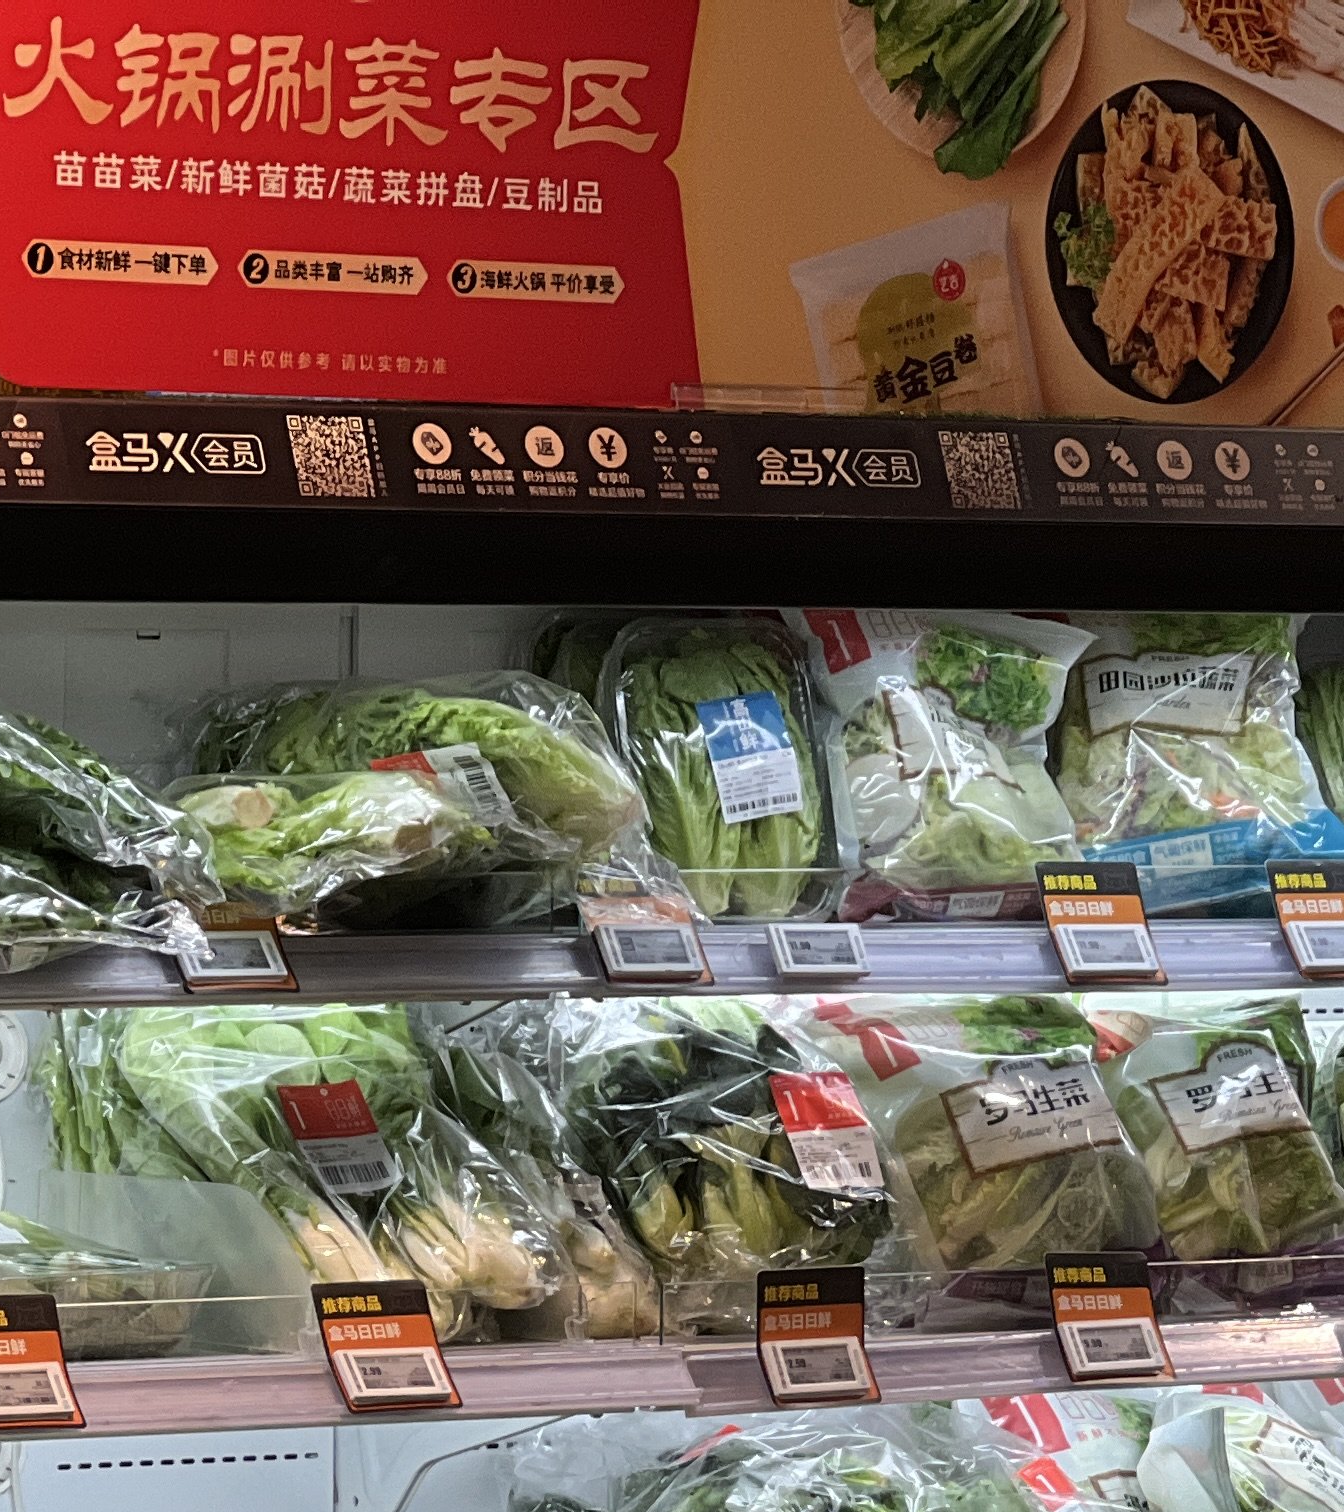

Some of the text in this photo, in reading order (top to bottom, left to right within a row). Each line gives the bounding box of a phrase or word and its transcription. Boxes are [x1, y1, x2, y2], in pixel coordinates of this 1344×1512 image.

[2, 15, 660, 154] 火锅涮菜专区
[53, 150, 604, 215] 苗苗菜/新鲜菌菇/蔬菜拼盘/豆制品
[57, 247, 132, 275] 食材新鲜
[135, 251, 209, 277] 一键下单
[274, 258, 343, 282] 品类丰富
[346, 262, 415, 287] 一站购齐
[480, 268, 546, 292] 海鲜火锅
[550, 272, 616, 296] 平价享受
[342, 351, 449, 376] 请以实物为准
[1044, 873, 1098, 892] 推荐商品
[1275, 872, 1327, 890] 推荐商品
[1049, 899, 1115, 917] 盒马日日鲜
[1279, 898, 1344, 916] 盒马日日鲜
[1215, 1046, 1253, 1064] FRESH
[1052, 1267, 1107, 1285] 推荐商品
[763, 1285, 820, 1302] 推荐商品
[1057, 1292, 1124, 1312] 盒马日日鲜
[321, 1295, 383, 1314] 推荐商品
[327, 1320, 402, 1341] 盒马日日鲜
[763, 1311, 833, 1331] 盒马日日鲜
